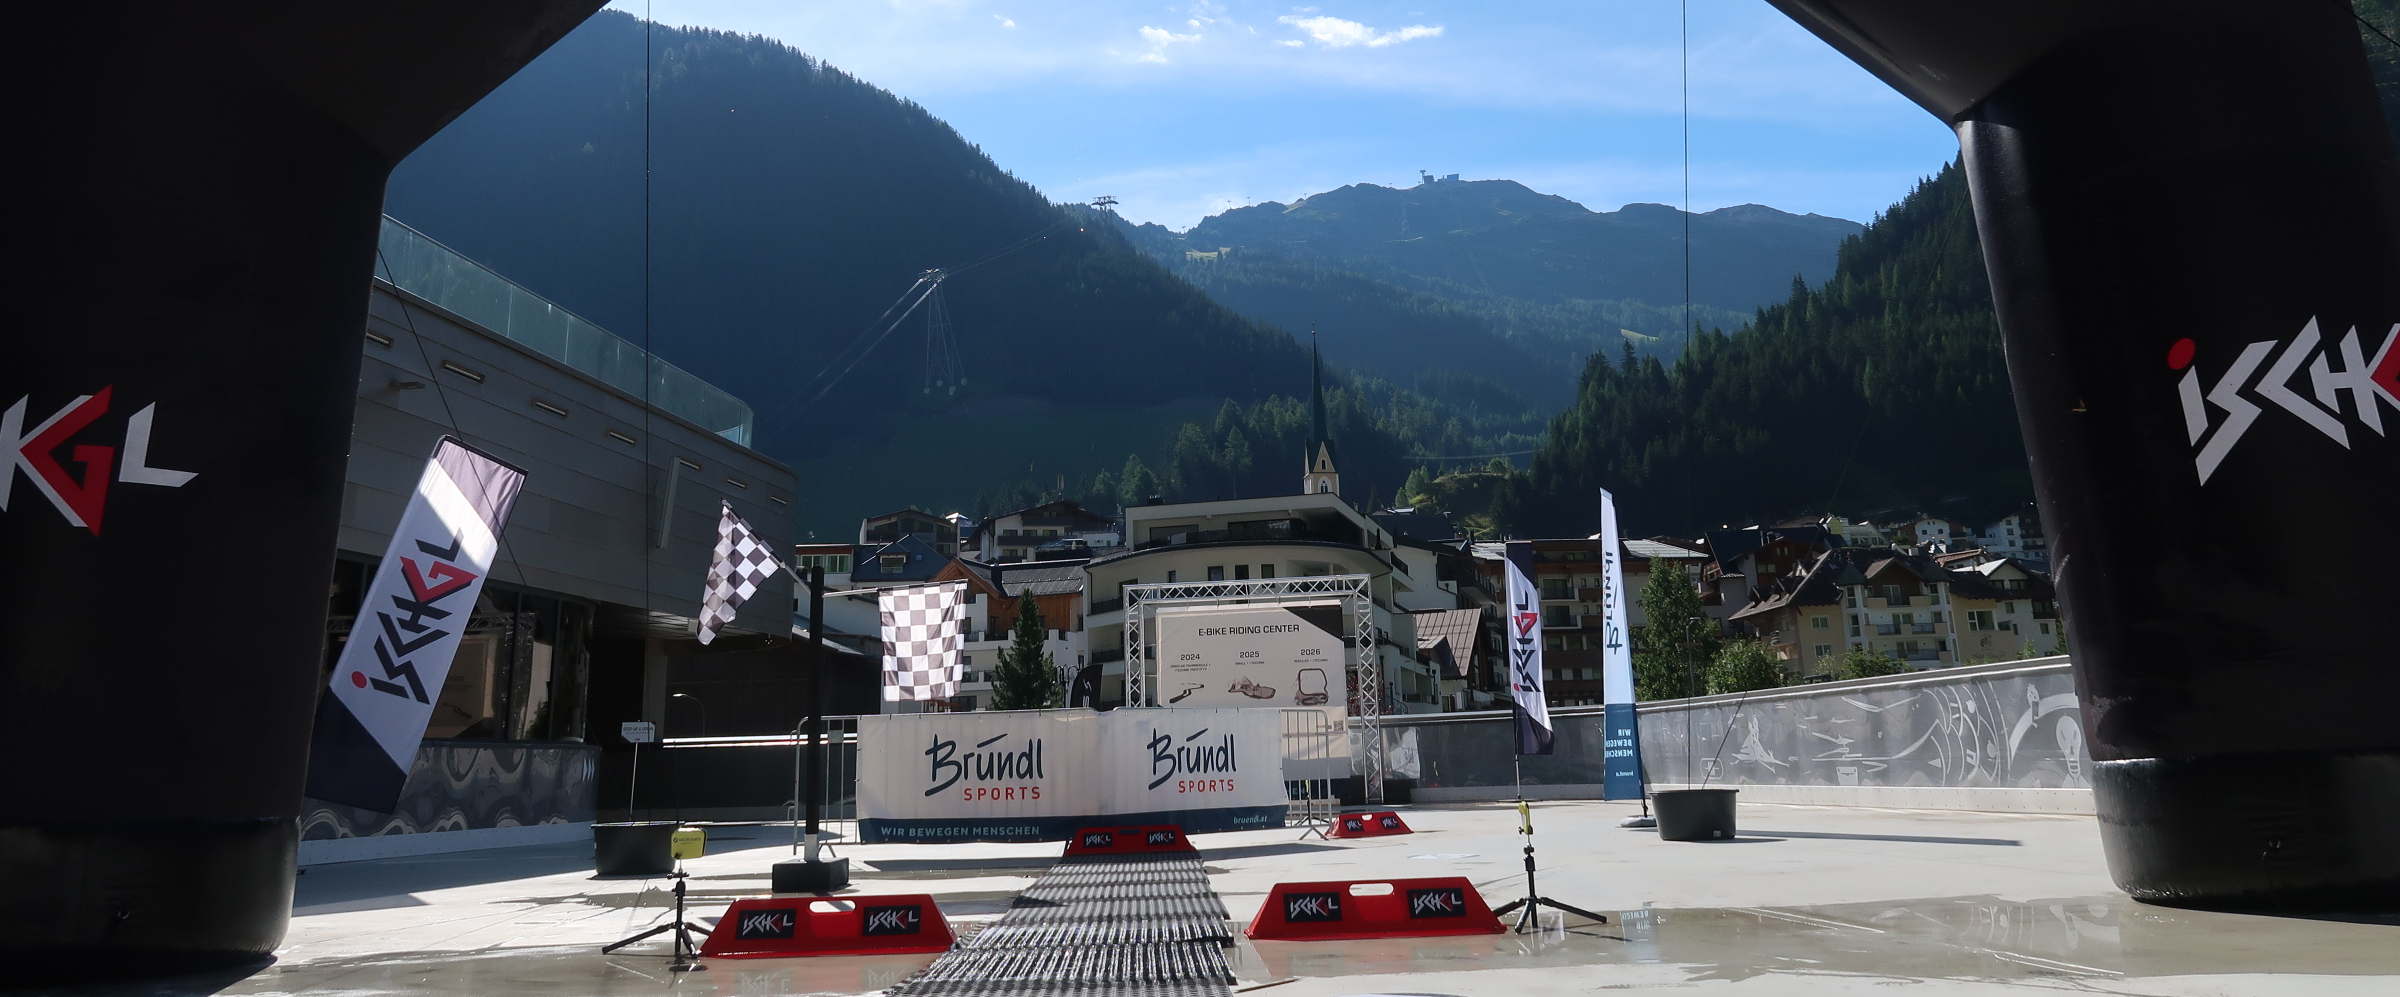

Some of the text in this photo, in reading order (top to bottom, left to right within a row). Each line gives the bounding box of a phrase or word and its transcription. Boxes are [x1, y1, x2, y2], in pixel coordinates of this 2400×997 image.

[1198, 624, 1300, 637] E-BIKE RIDING CENTER
[1180, 653, 1200, 661] 2024
[1239, 651, 1260, 659] 2025
[1300, 648, 1321, 656] 2026
[1178, 779, 1235, 793] SPORTS
[963, 786, 1041, 801] SPORTS
[1233, 815, 1268, 824] bruendl.at
[881, 826, 1041, 837] WIR BEWEGEN MENSCHEN
